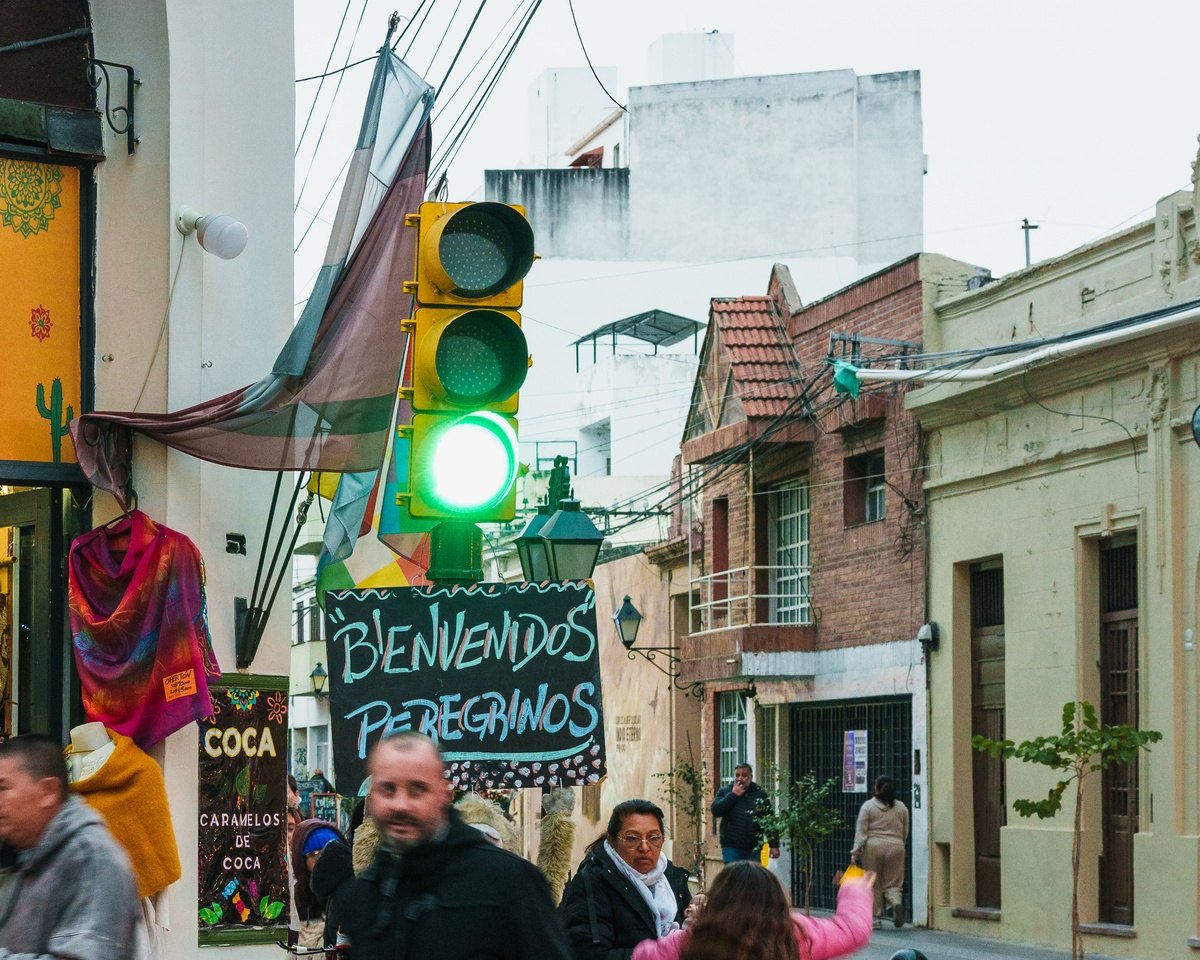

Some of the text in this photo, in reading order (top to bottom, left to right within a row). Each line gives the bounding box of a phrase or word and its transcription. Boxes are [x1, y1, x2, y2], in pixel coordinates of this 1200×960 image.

[343, 681, 600, 760] PEREGRINOS
[204, 727, 277, 758] COCA
[200, 813, 280, 827] CARAMELOS
[235, 834, 250, 848] DE
[222, 856, 261, 870] COCA
